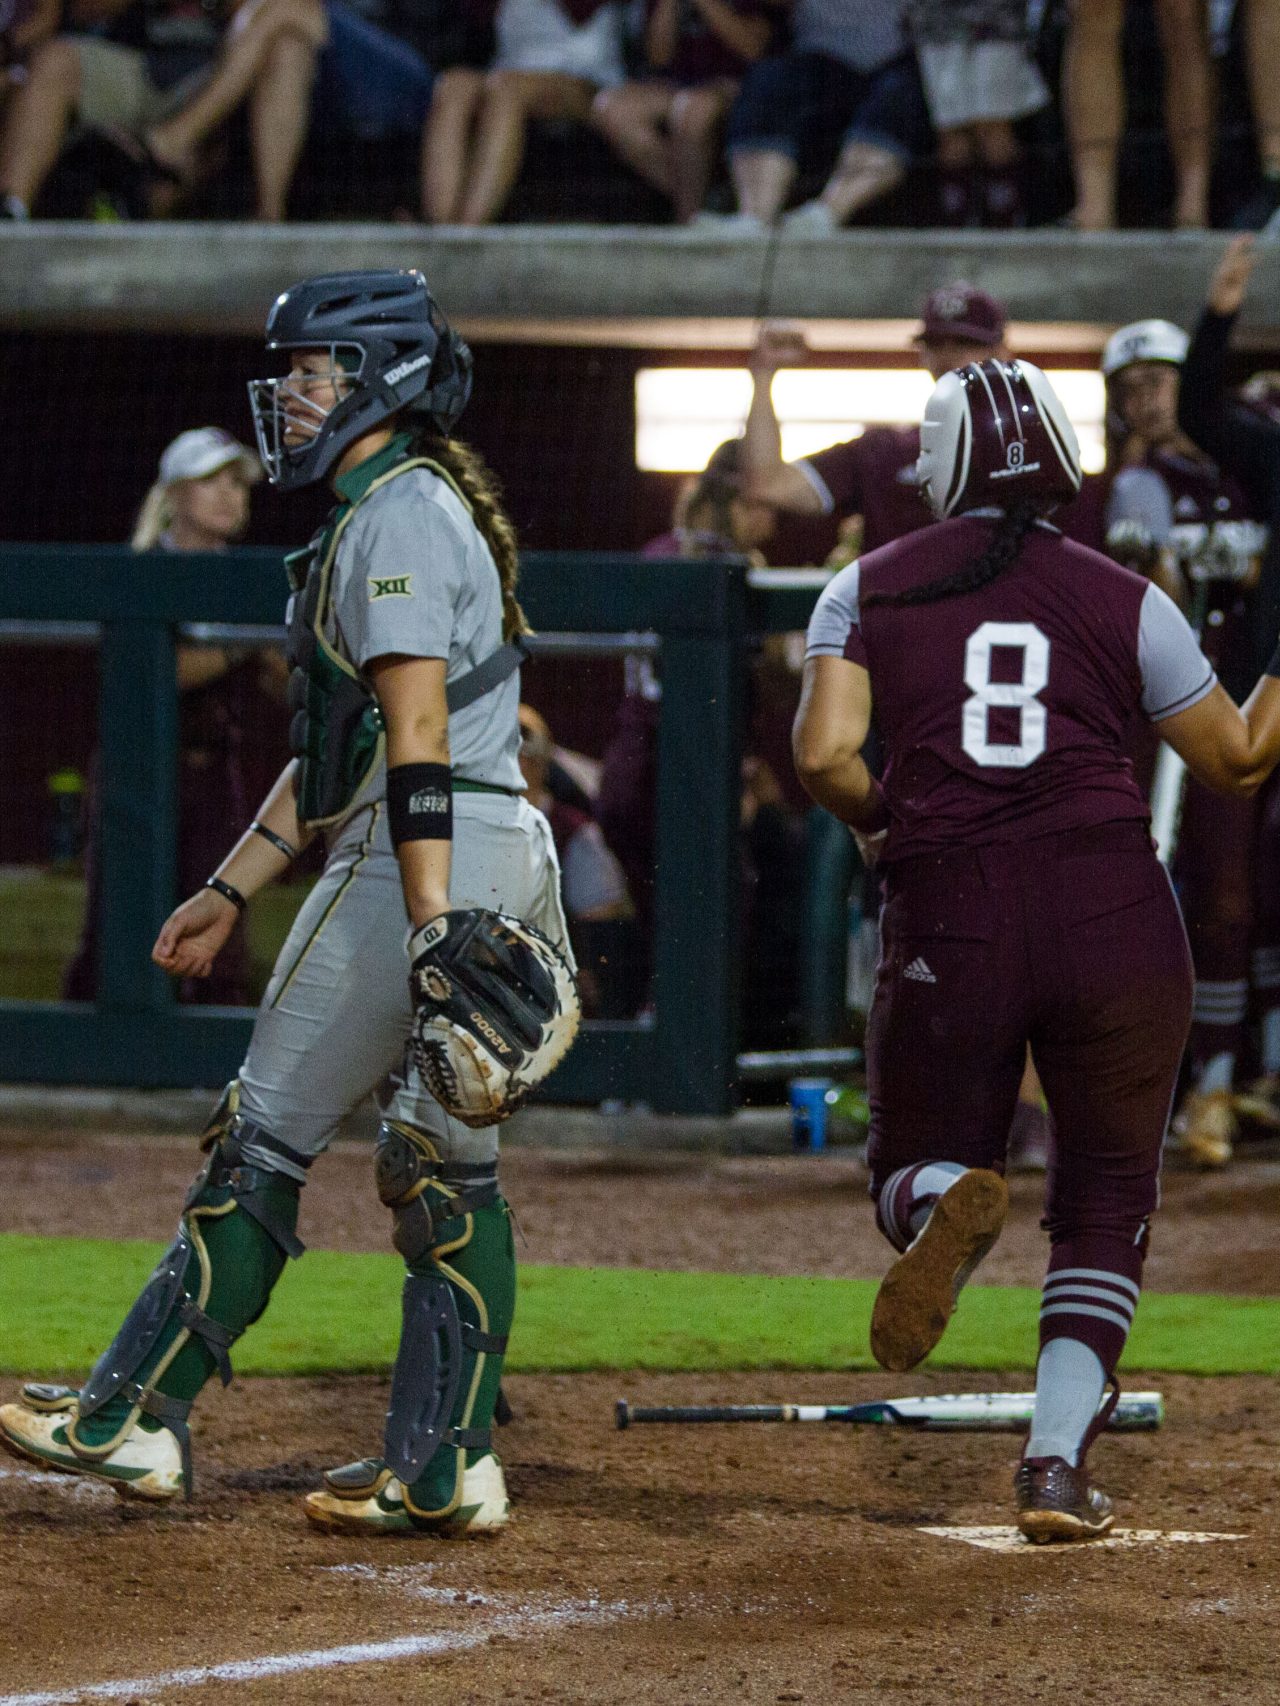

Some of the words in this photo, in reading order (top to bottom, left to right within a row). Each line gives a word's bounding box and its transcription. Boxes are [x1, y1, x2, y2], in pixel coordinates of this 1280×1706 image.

[1007, 442, 1024, 469] 8
[962, 621, 1050, 768] 8
[903, 969, 937, 983] adidas
[470, 1011, 512, 1053] A2000
